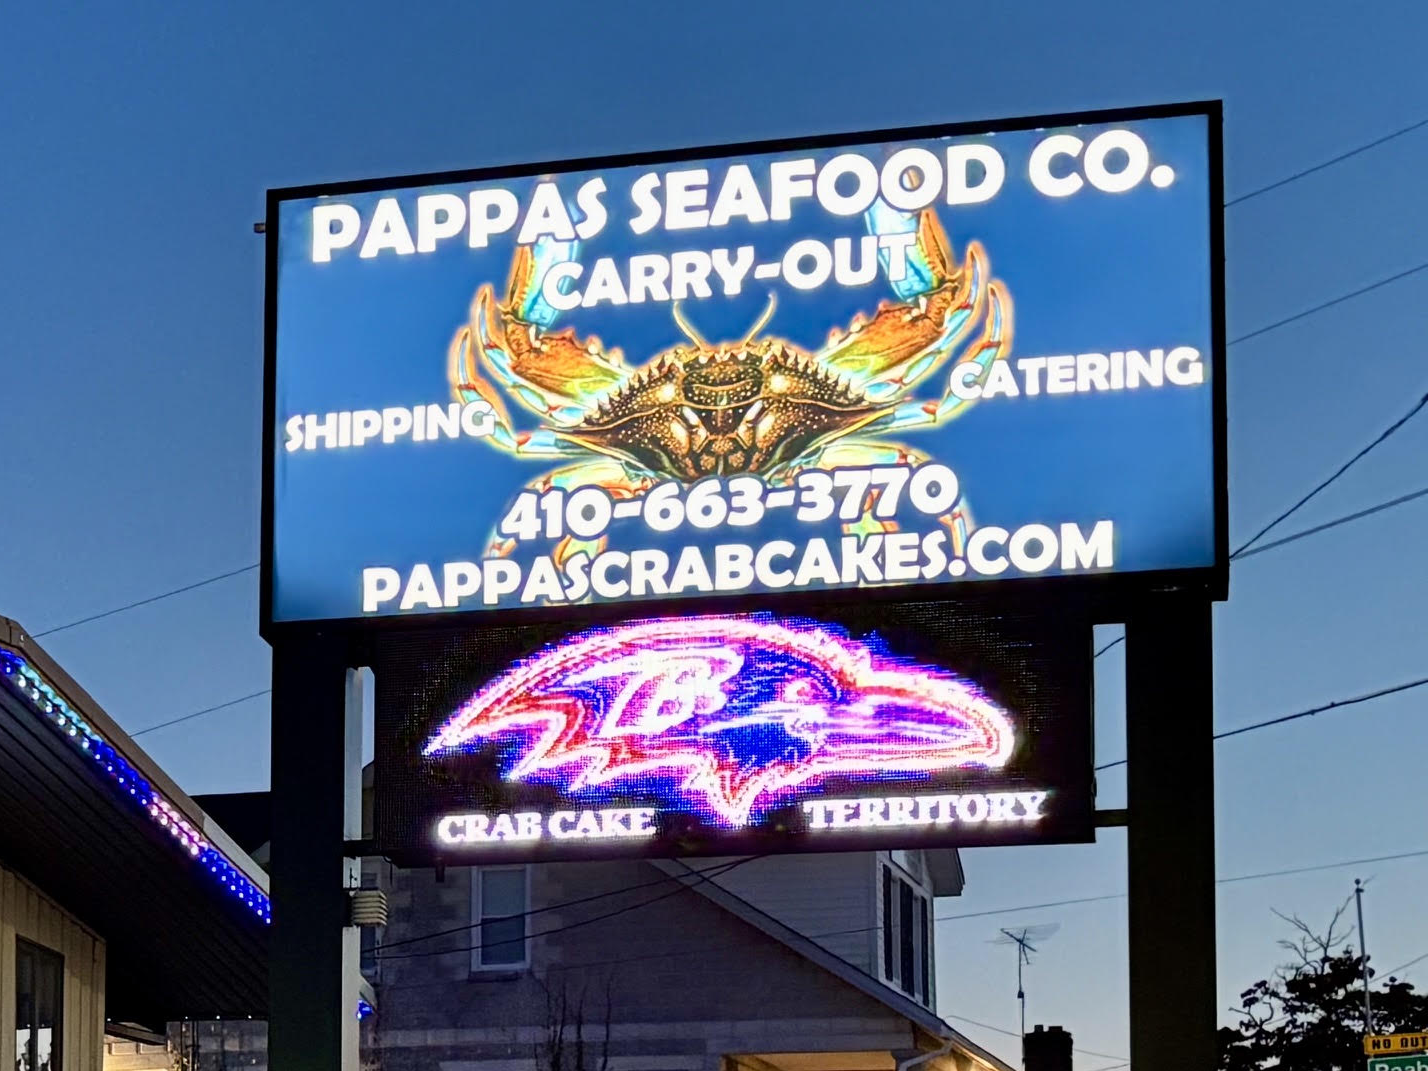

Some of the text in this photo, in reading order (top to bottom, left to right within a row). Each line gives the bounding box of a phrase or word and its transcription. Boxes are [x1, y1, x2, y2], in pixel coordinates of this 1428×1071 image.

[311, 129, 1175, 263] PAPPAS SEAFOOD CO.
[542, 233, 917, 312] CARRY-OUT
[949, 347, 1204, 401] CATERING
[284, 400, 498, 453] SHIPPING
[500, 463, 960, 541] 410-663-3770
[361, 519, 1114, 614] PAPPASCRABCAKES.COM
[437, 791, 1051, 845] CRAB CAKE TERRITORY
[1372, 1038, 1391, 1050] NO
